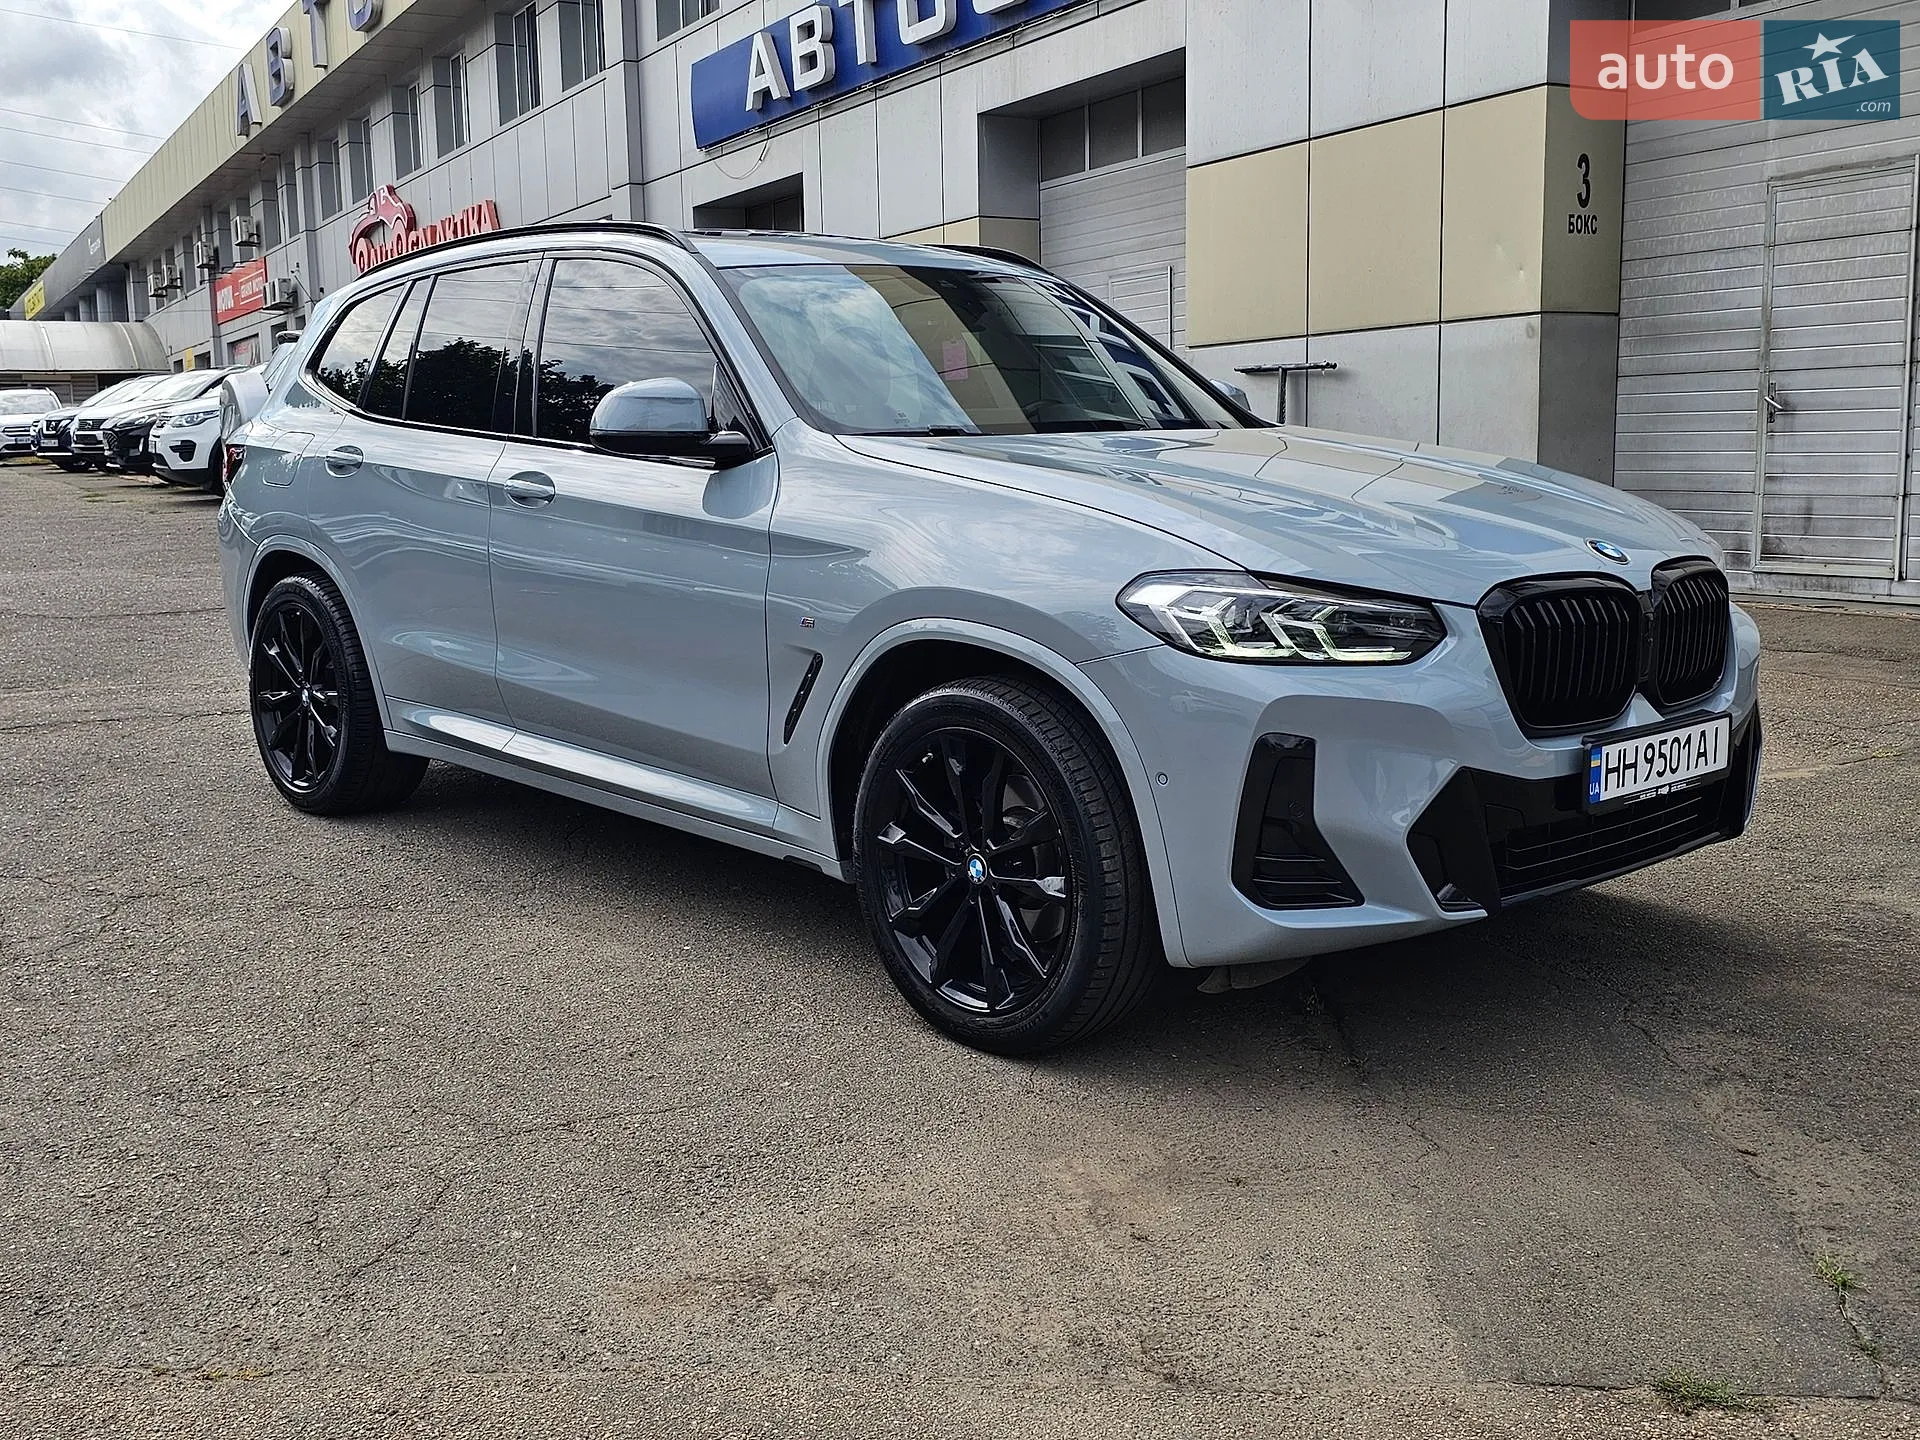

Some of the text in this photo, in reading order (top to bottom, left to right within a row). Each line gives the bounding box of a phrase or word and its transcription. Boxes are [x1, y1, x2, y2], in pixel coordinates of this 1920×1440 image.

[745, 0, 1028, 112] АВТ
[1577, 153, 1590, 208] 3
[1568, 213, 1598, 235] БОКС
[1589, 783, 1600, 795] UA
